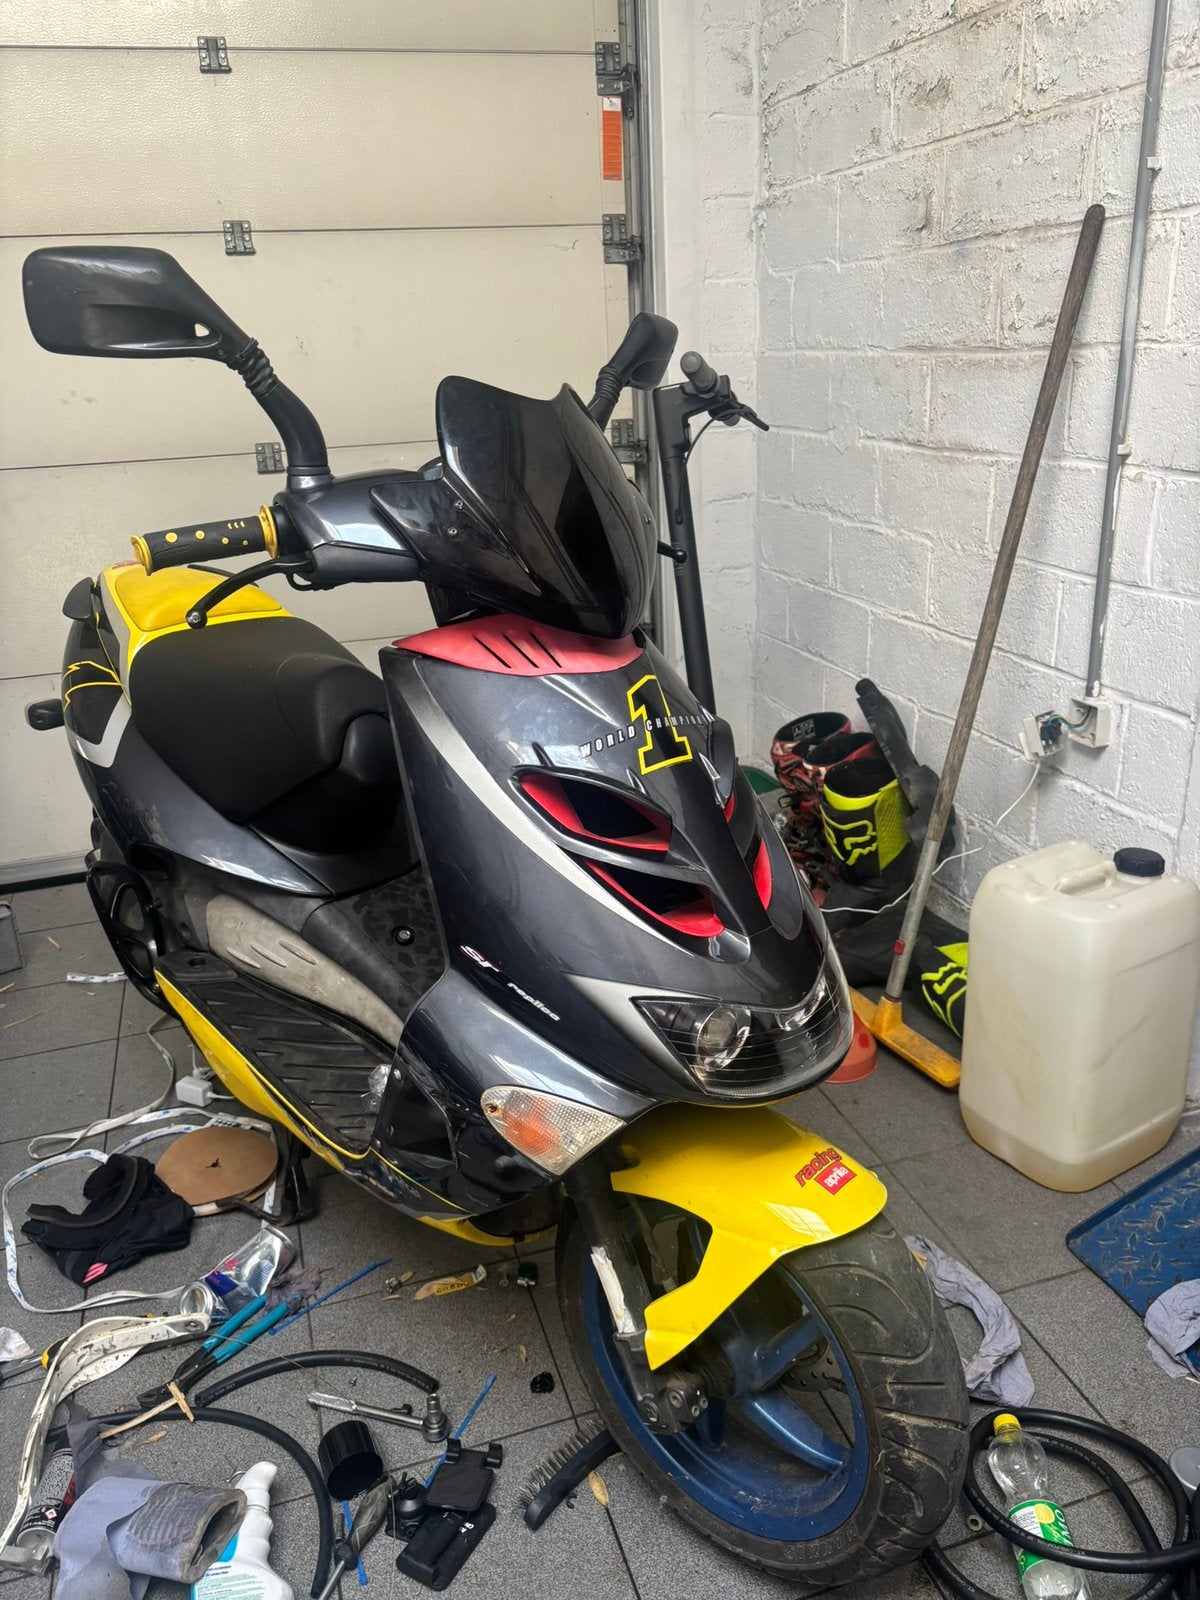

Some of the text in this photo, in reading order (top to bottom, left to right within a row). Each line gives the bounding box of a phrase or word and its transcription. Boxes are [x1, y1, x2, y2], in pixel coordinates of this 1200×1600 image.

[579, 725, 636, 758] WORLD
[626, 674, 693, 775] 1
[507, 982, 561, 1021] replica
[794, 1147, 842, 1188] racing
